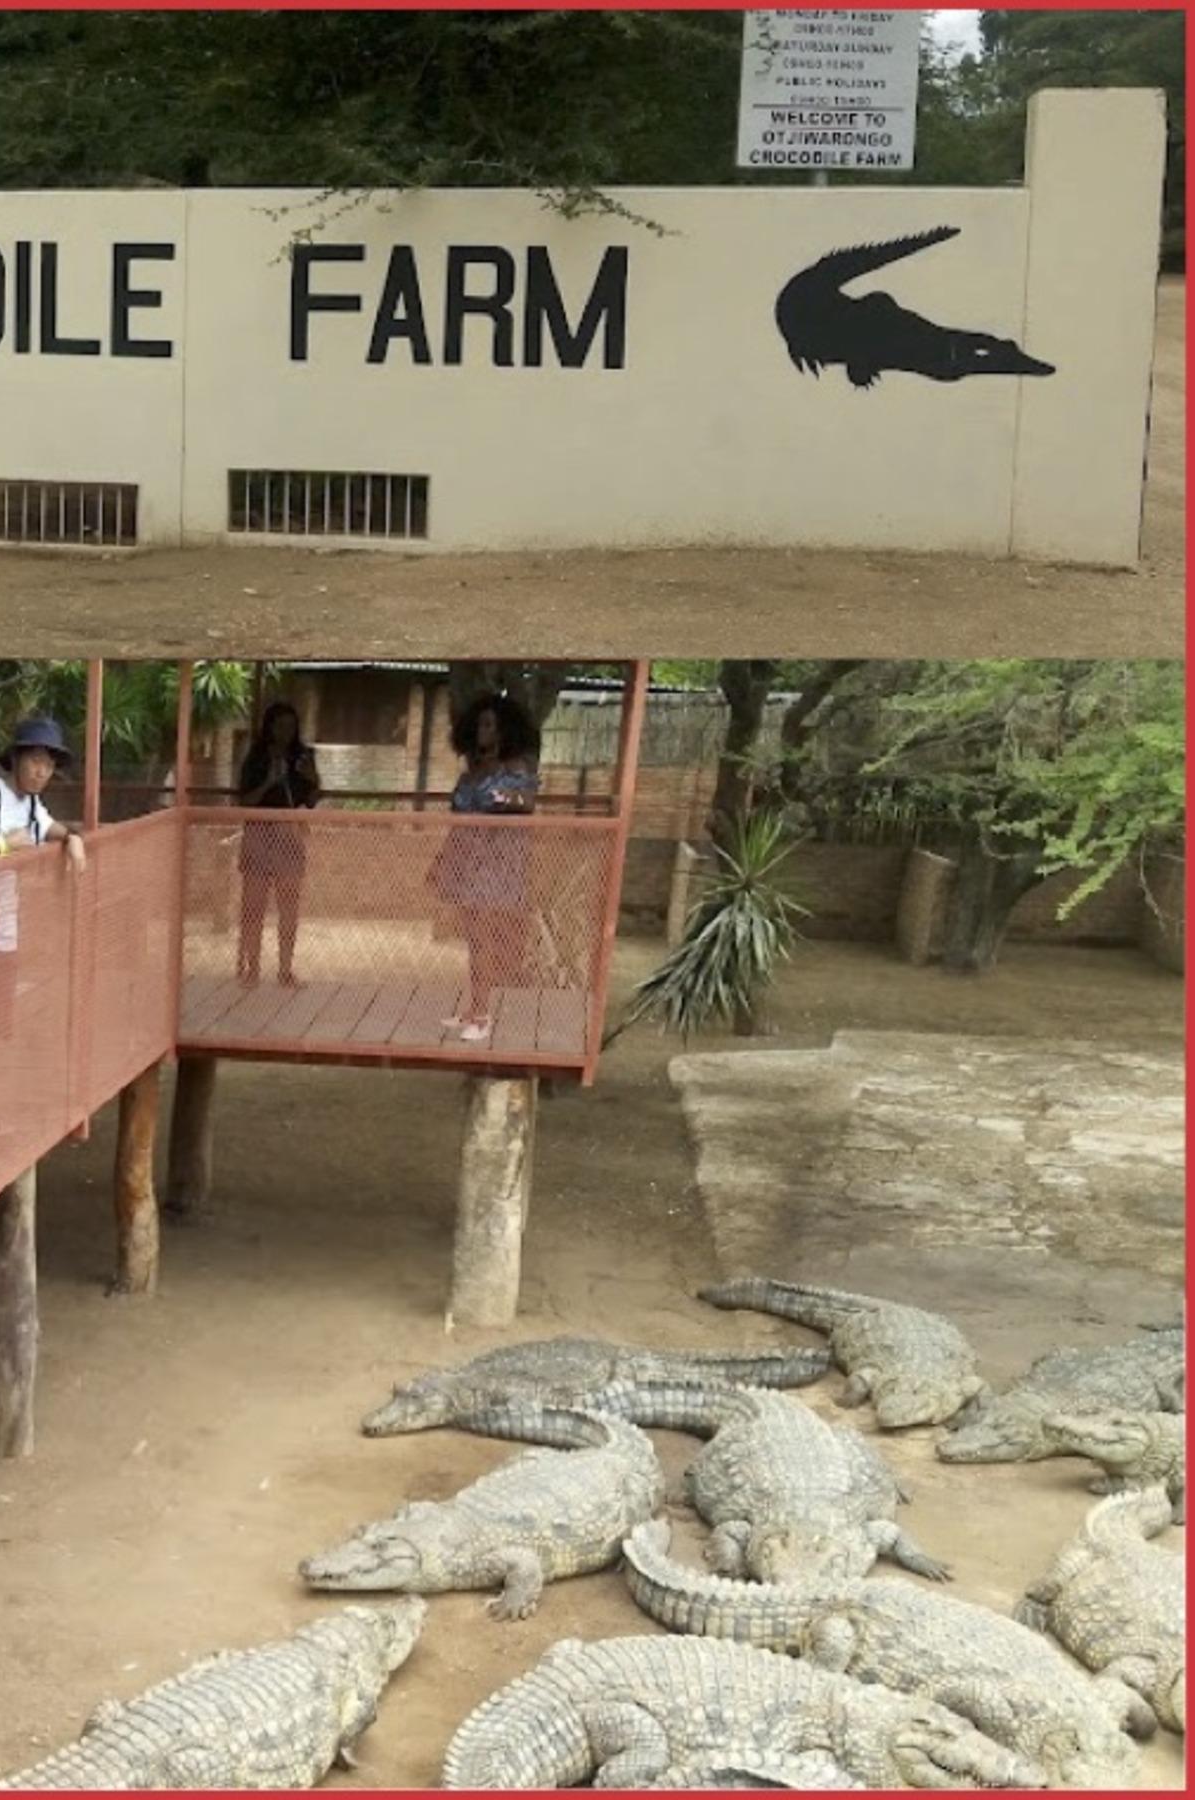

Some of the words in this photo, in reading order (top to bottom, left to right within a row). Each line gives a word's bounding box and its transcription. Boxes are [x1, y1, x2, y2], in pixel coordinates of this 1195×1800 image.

[776, 76, 822, 87] PUBLIC
[826, 78, 886, 89] HOLIDAYS
[770, 111, 858, 126] WELCOME
[864, 113, 887, 128] TO
[762, 131, 893, 147] OTJIWARONGO
[749, 151, 851, 165] CROCODILE
[856, 152, 901, 166] FARM
[290, 242, 629, 370] FARM
